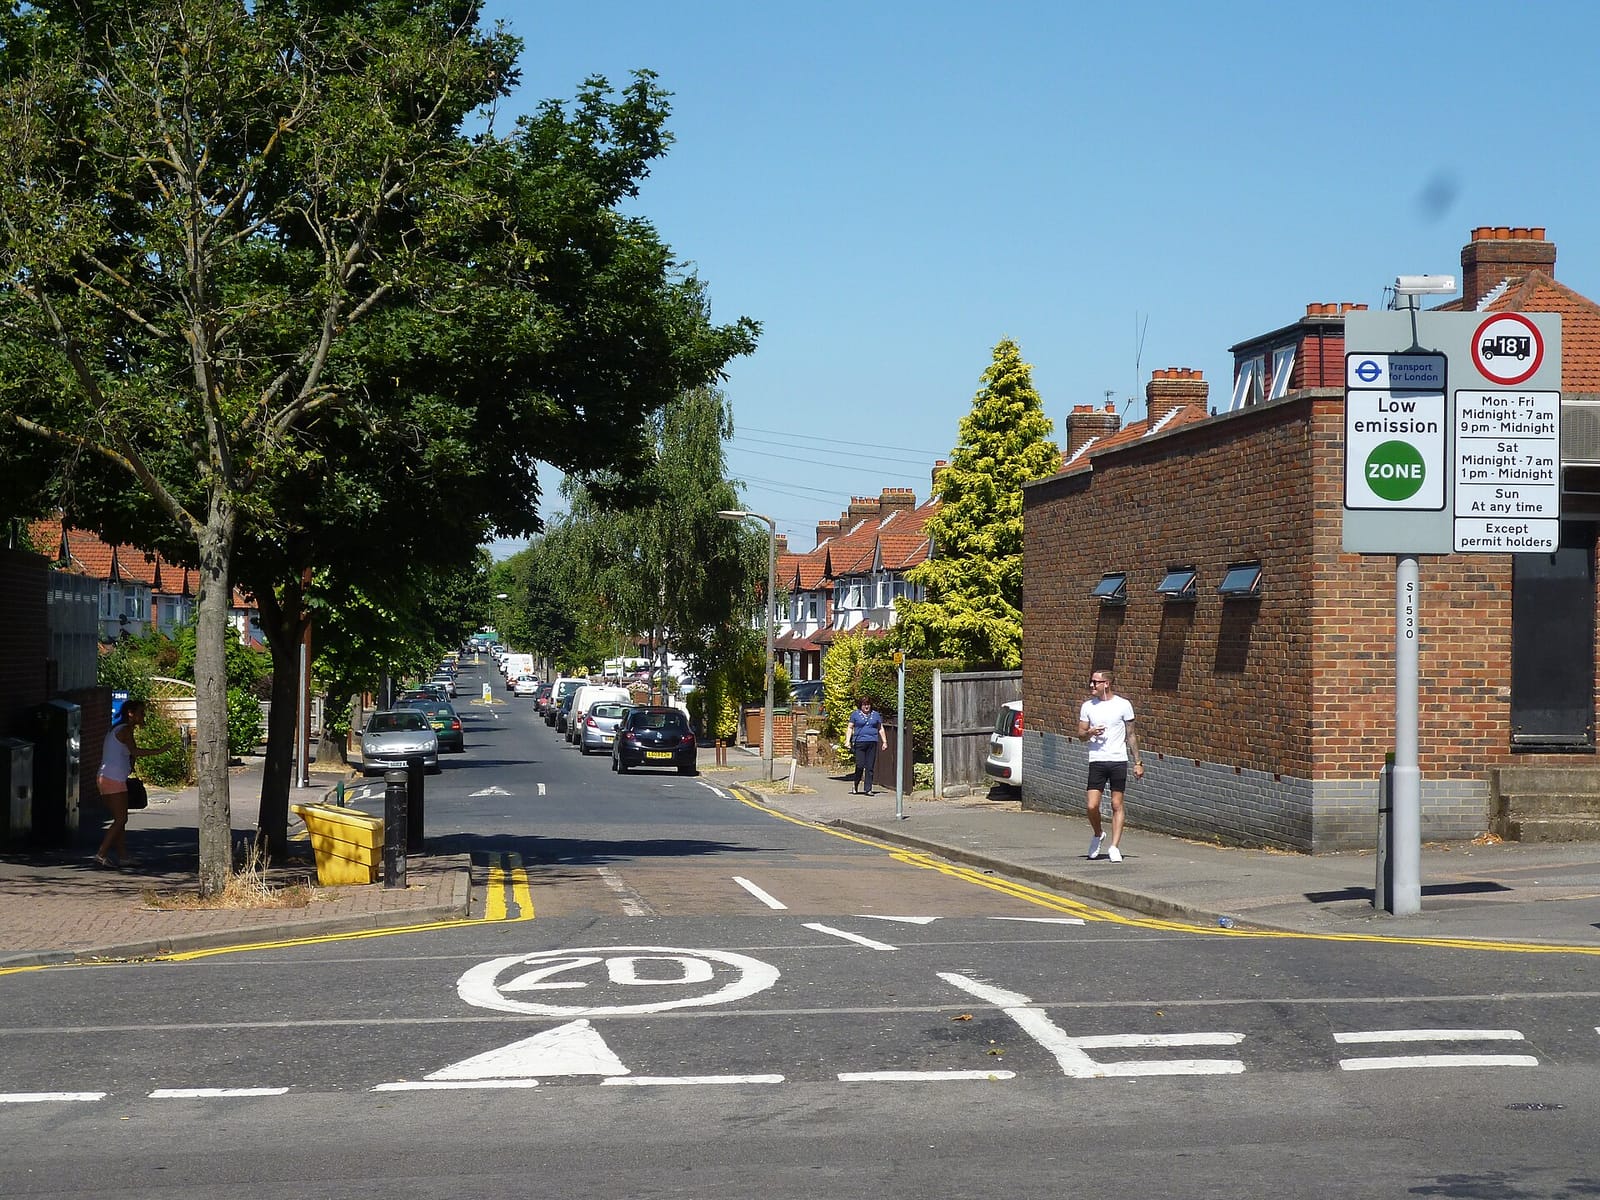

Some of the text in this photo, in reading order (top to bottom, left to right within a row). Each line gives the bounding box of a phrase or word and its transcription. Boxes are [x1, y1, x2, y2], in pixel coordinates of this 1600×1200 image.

[1389, 363, 1432, 372] Transport
[1389, 373, 1439, 381] for London
[1378, 397, 1416, 413] Low
[1482, 396, 1508, 406] Mon
[1519, 397, 1534, 406] Fri
[1462, 409, 1517, 421] Midnight
[1354, 418, 1438, 433] emission
[1501, 423, 1555, 434] Midnight
[1497, 443, 1518, 452] Sat
[1462, 455, 1517, 467] Midnight
[1369, 464, 1422, 479] ZONE
[1499, 469, 1553, 480] Midnight
[1495, 489, 1519, 499] Sun
[1471, 501, 1543, 513] At any time
[1486, 523, 1528, 535] Except
[1461, 536, 1552, 547] permit holders
[1406, 582, 1414, 639] S1530
[496, 956, 715, 992] 20
